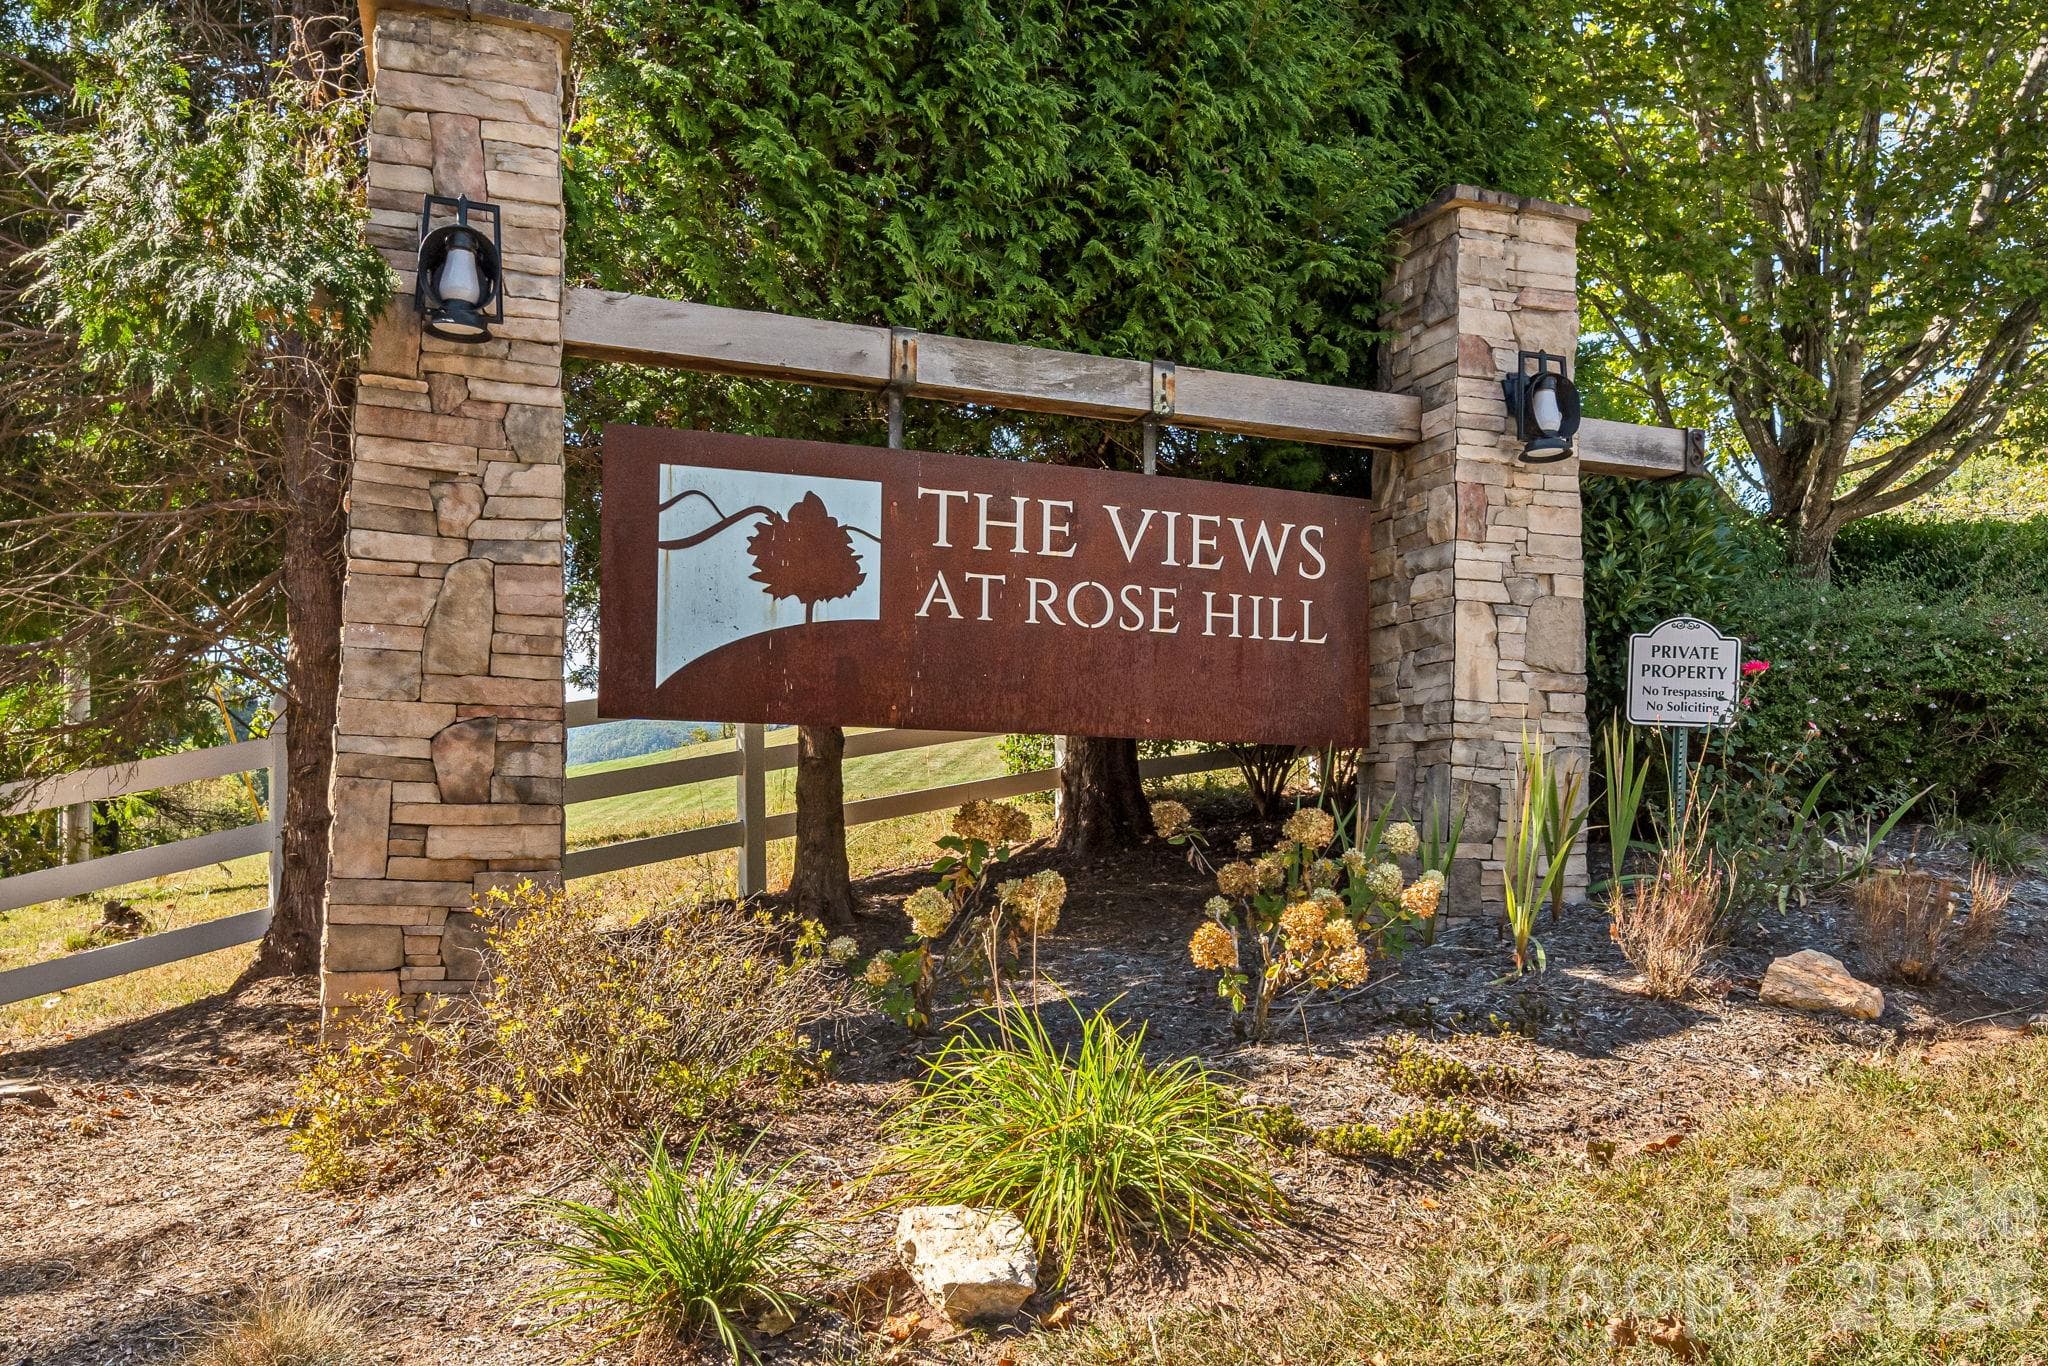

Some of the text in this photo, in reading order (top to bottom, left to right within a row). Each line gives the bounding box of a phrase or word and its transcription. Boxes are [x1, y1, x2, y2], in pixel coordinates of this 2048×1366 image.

[917, 486, 1327, 580] THE VIEWS
[915, 570, 1328, 644] AT ROSE HILL
[1651, 645, 1719, 660] PRIVATE
[1641, 664, 1728, 680] PROPERTY
[1642, 686, 1659, 696] No
[1646, 701, 1719, 716] No Soliciting
